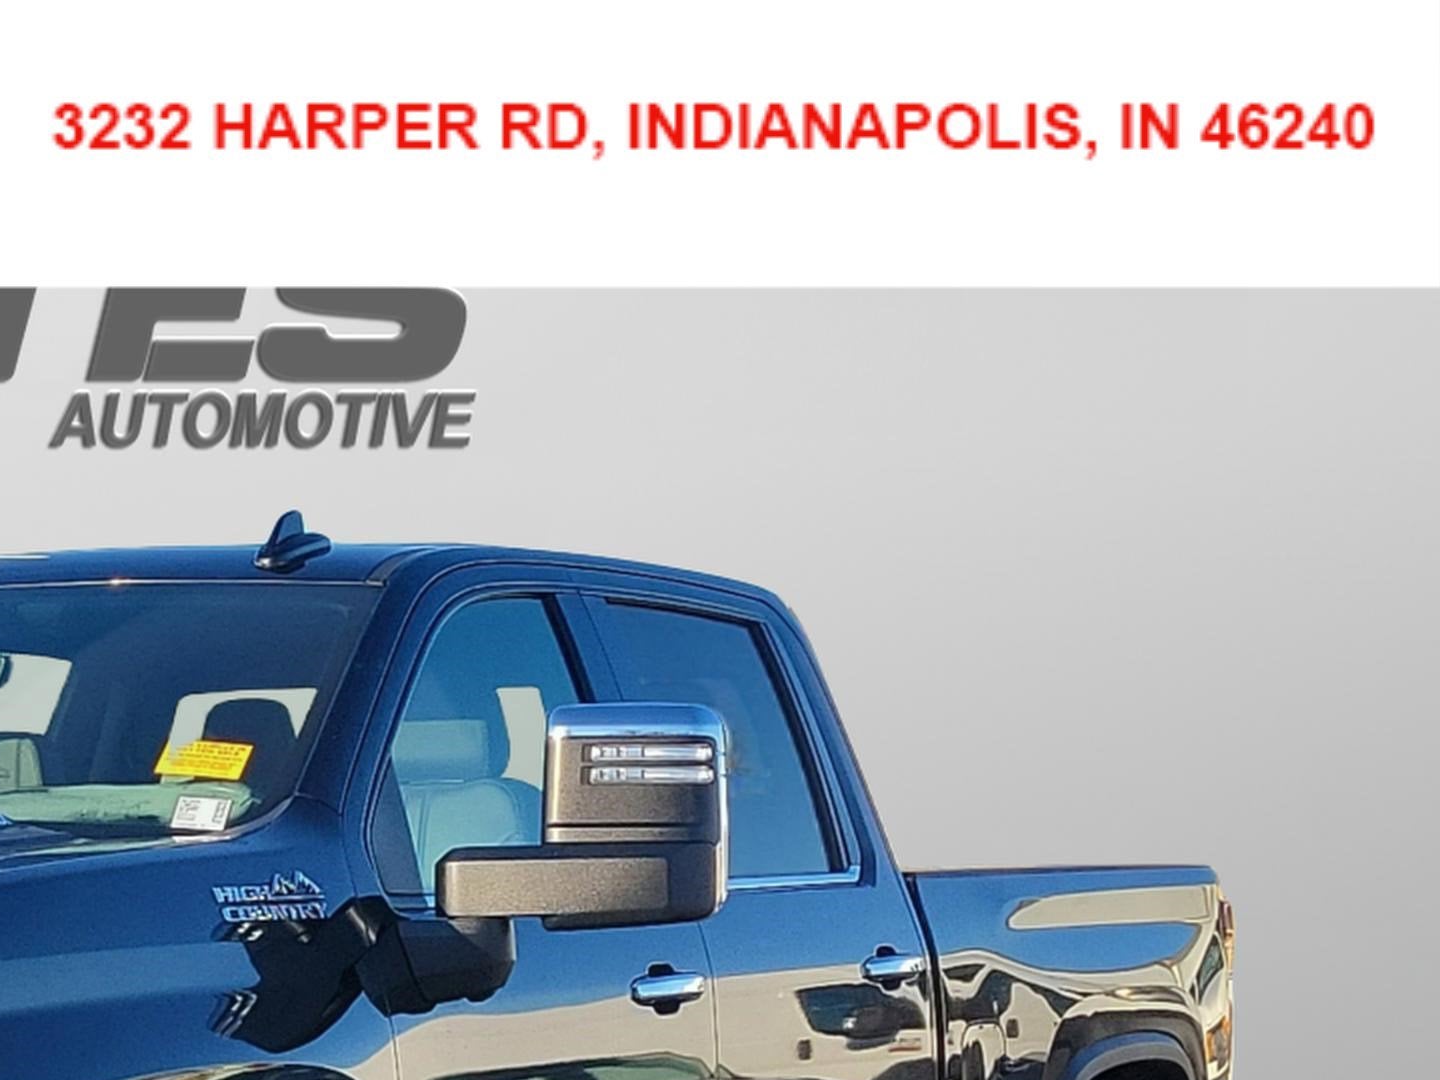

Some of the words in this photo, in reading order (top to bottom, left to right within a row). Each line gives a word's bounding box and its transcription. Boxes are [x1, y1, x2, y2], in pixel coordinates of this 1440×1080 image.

[48, 390, 476, 449] AUTOMOTIVE
[212, 885, 270, 904] HIGH
[221, 902, 327, 922] COUNTRY
